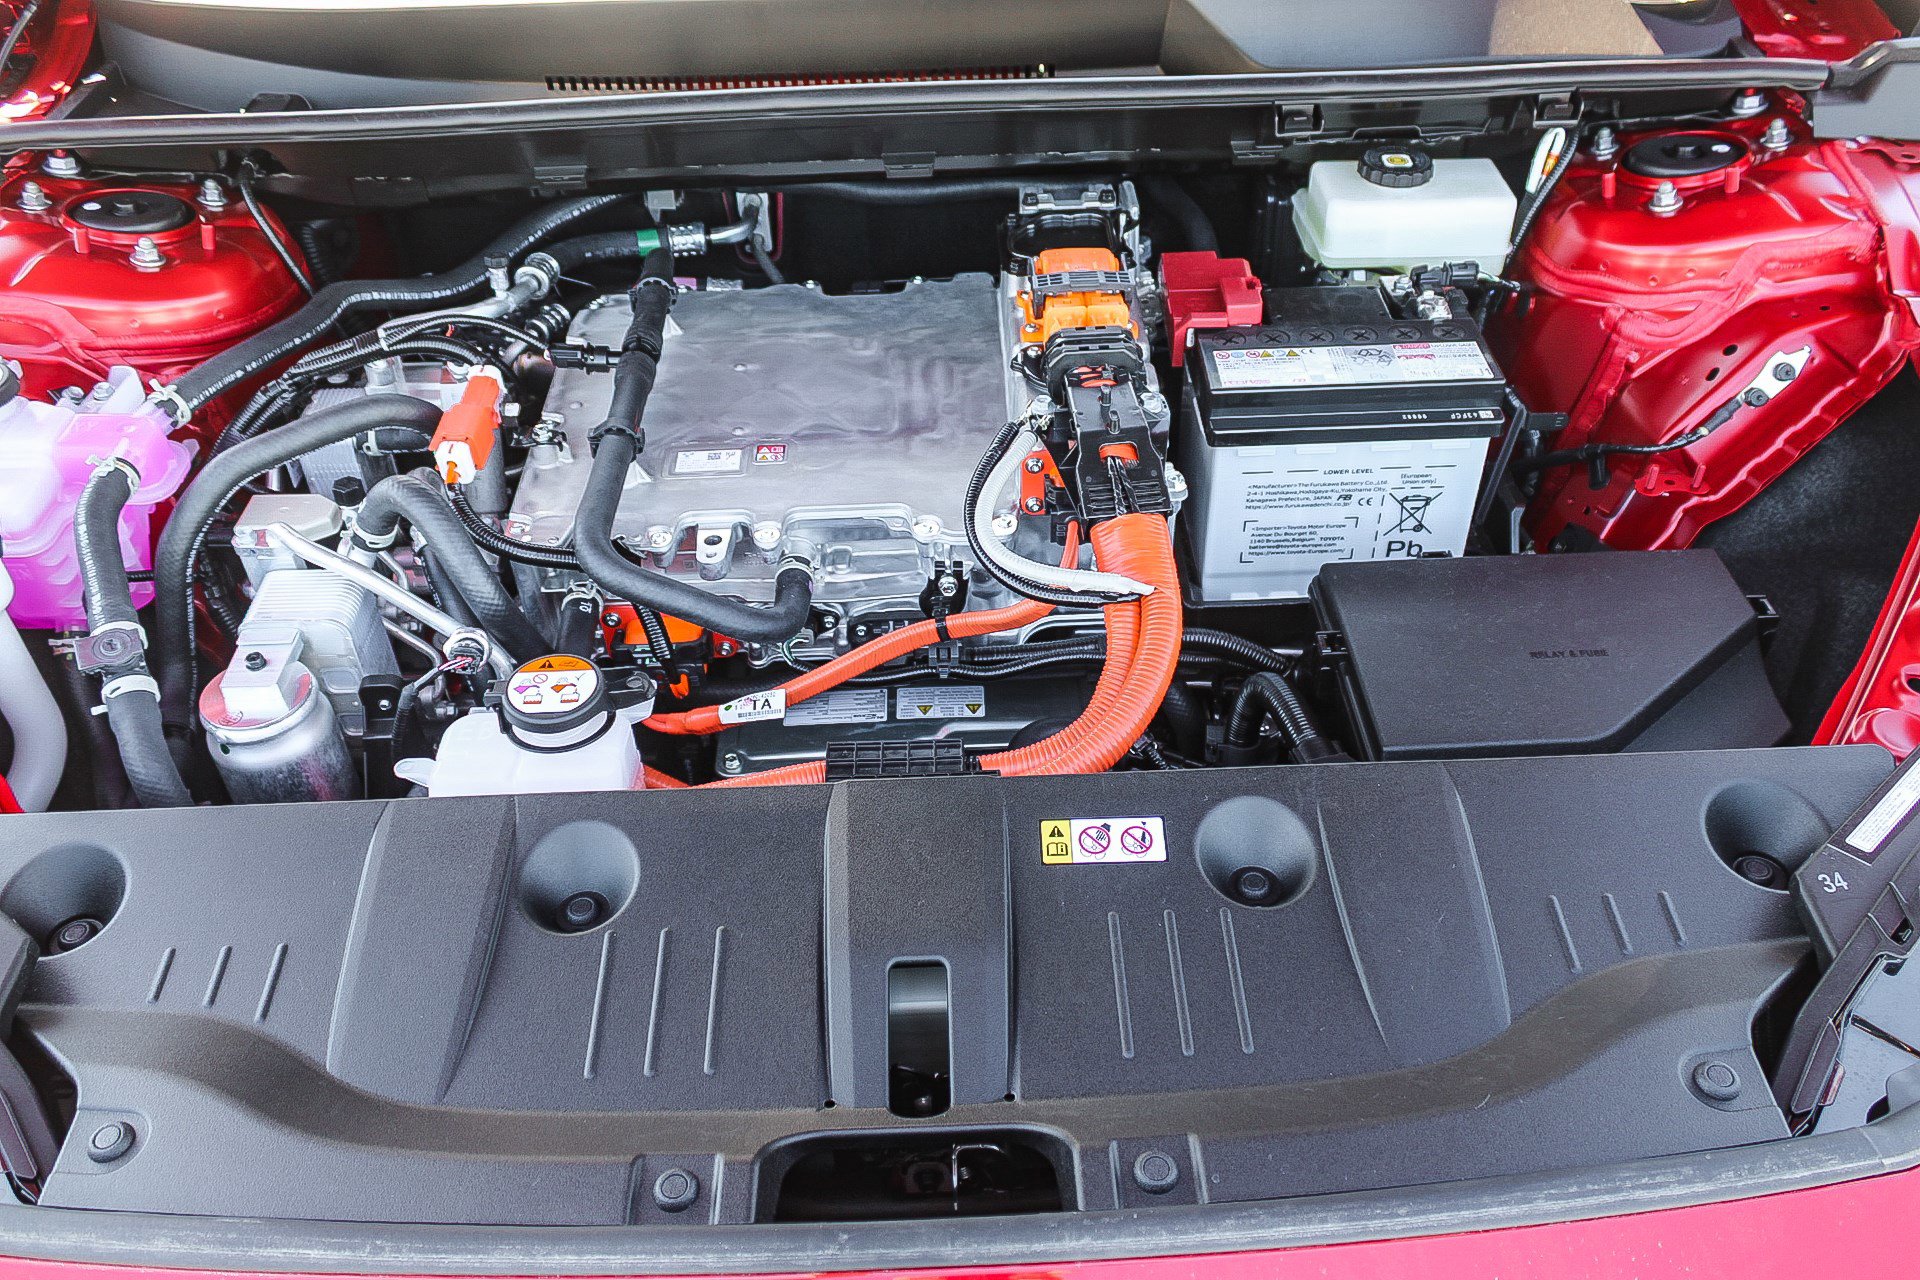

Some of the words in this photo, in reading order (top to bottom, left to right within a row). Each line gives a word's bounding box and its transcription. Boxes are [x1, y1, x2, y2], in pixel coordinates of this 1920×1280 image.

[1386, 540, 1423, 557] Pb
[752, 698, 772, 711] TA
[1818, 872, 1848, 893] 34
